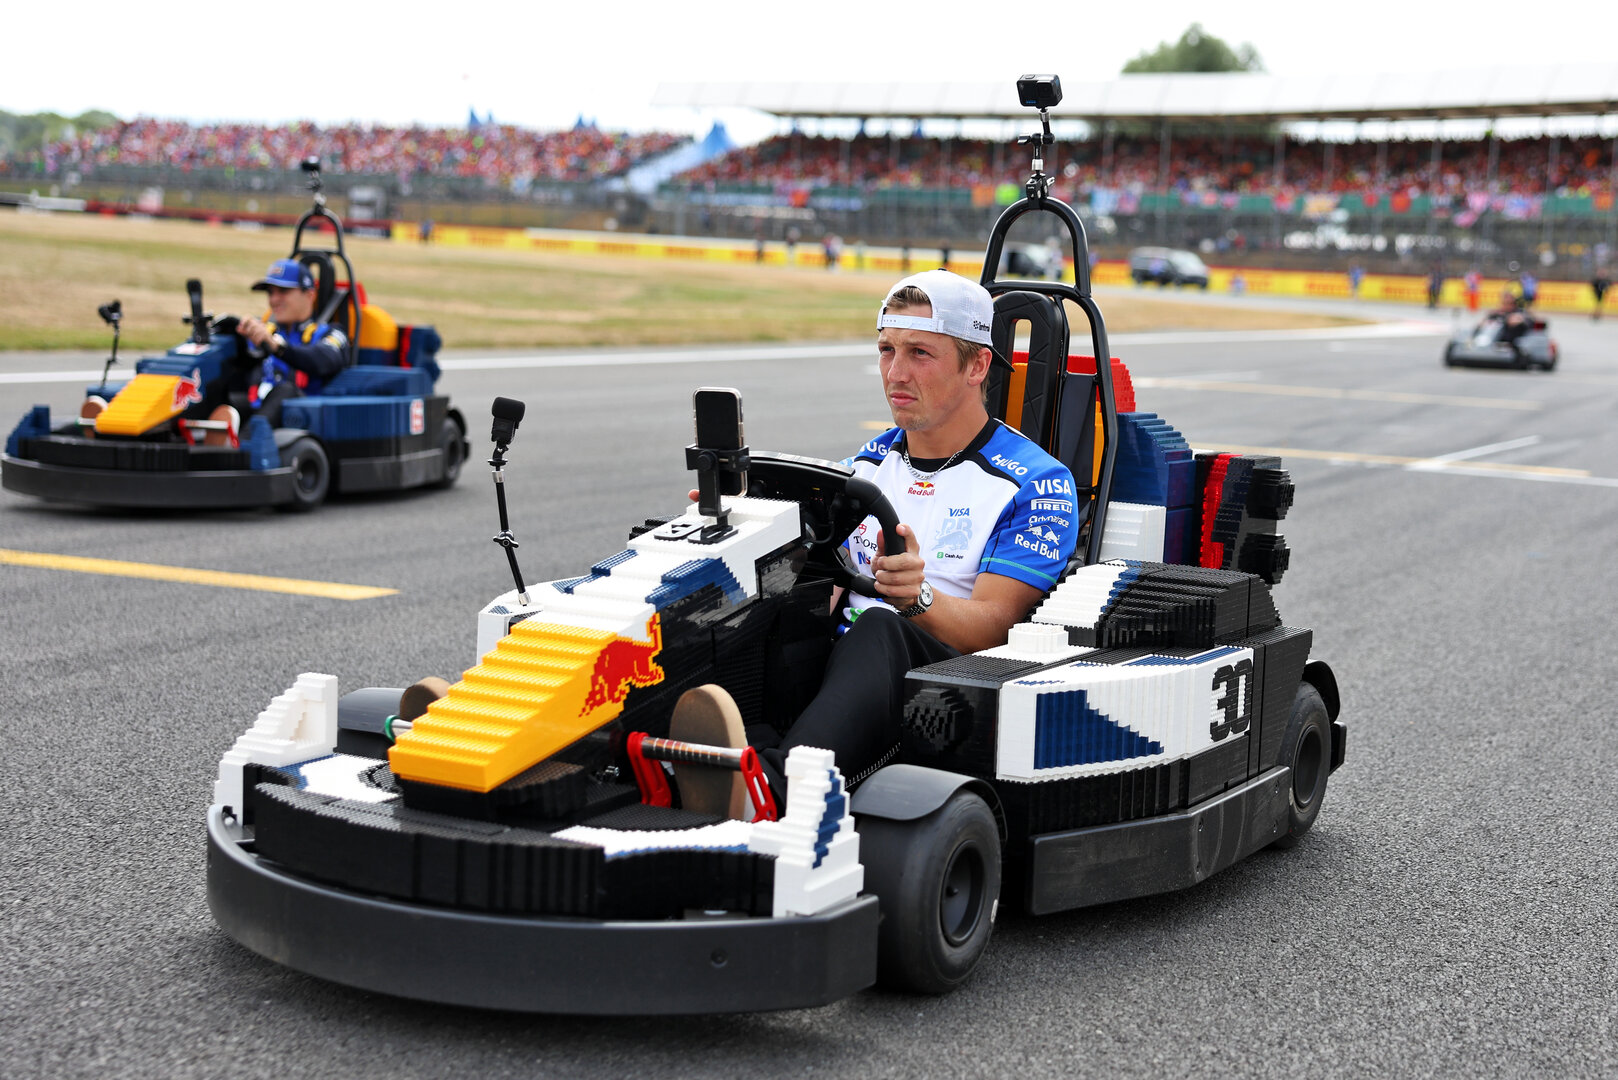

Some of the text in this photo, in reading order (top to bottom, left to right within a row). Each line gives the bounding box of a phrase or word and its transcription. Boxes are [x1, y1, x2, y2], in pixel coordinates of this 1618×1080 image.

[860, 441, 891, 456] UG
[991, 454, 1028, 476] HUGO
[907, 487, 922, 496] Red
[1030, 479, 1072, 496] VISA
[948, 508, 970, 517] VISA
[1030, 498, 1073, 514] PIRELLI
[1014, 533, 1060, 561] Red Bull
[1210, 658, 1253, 742] 30
